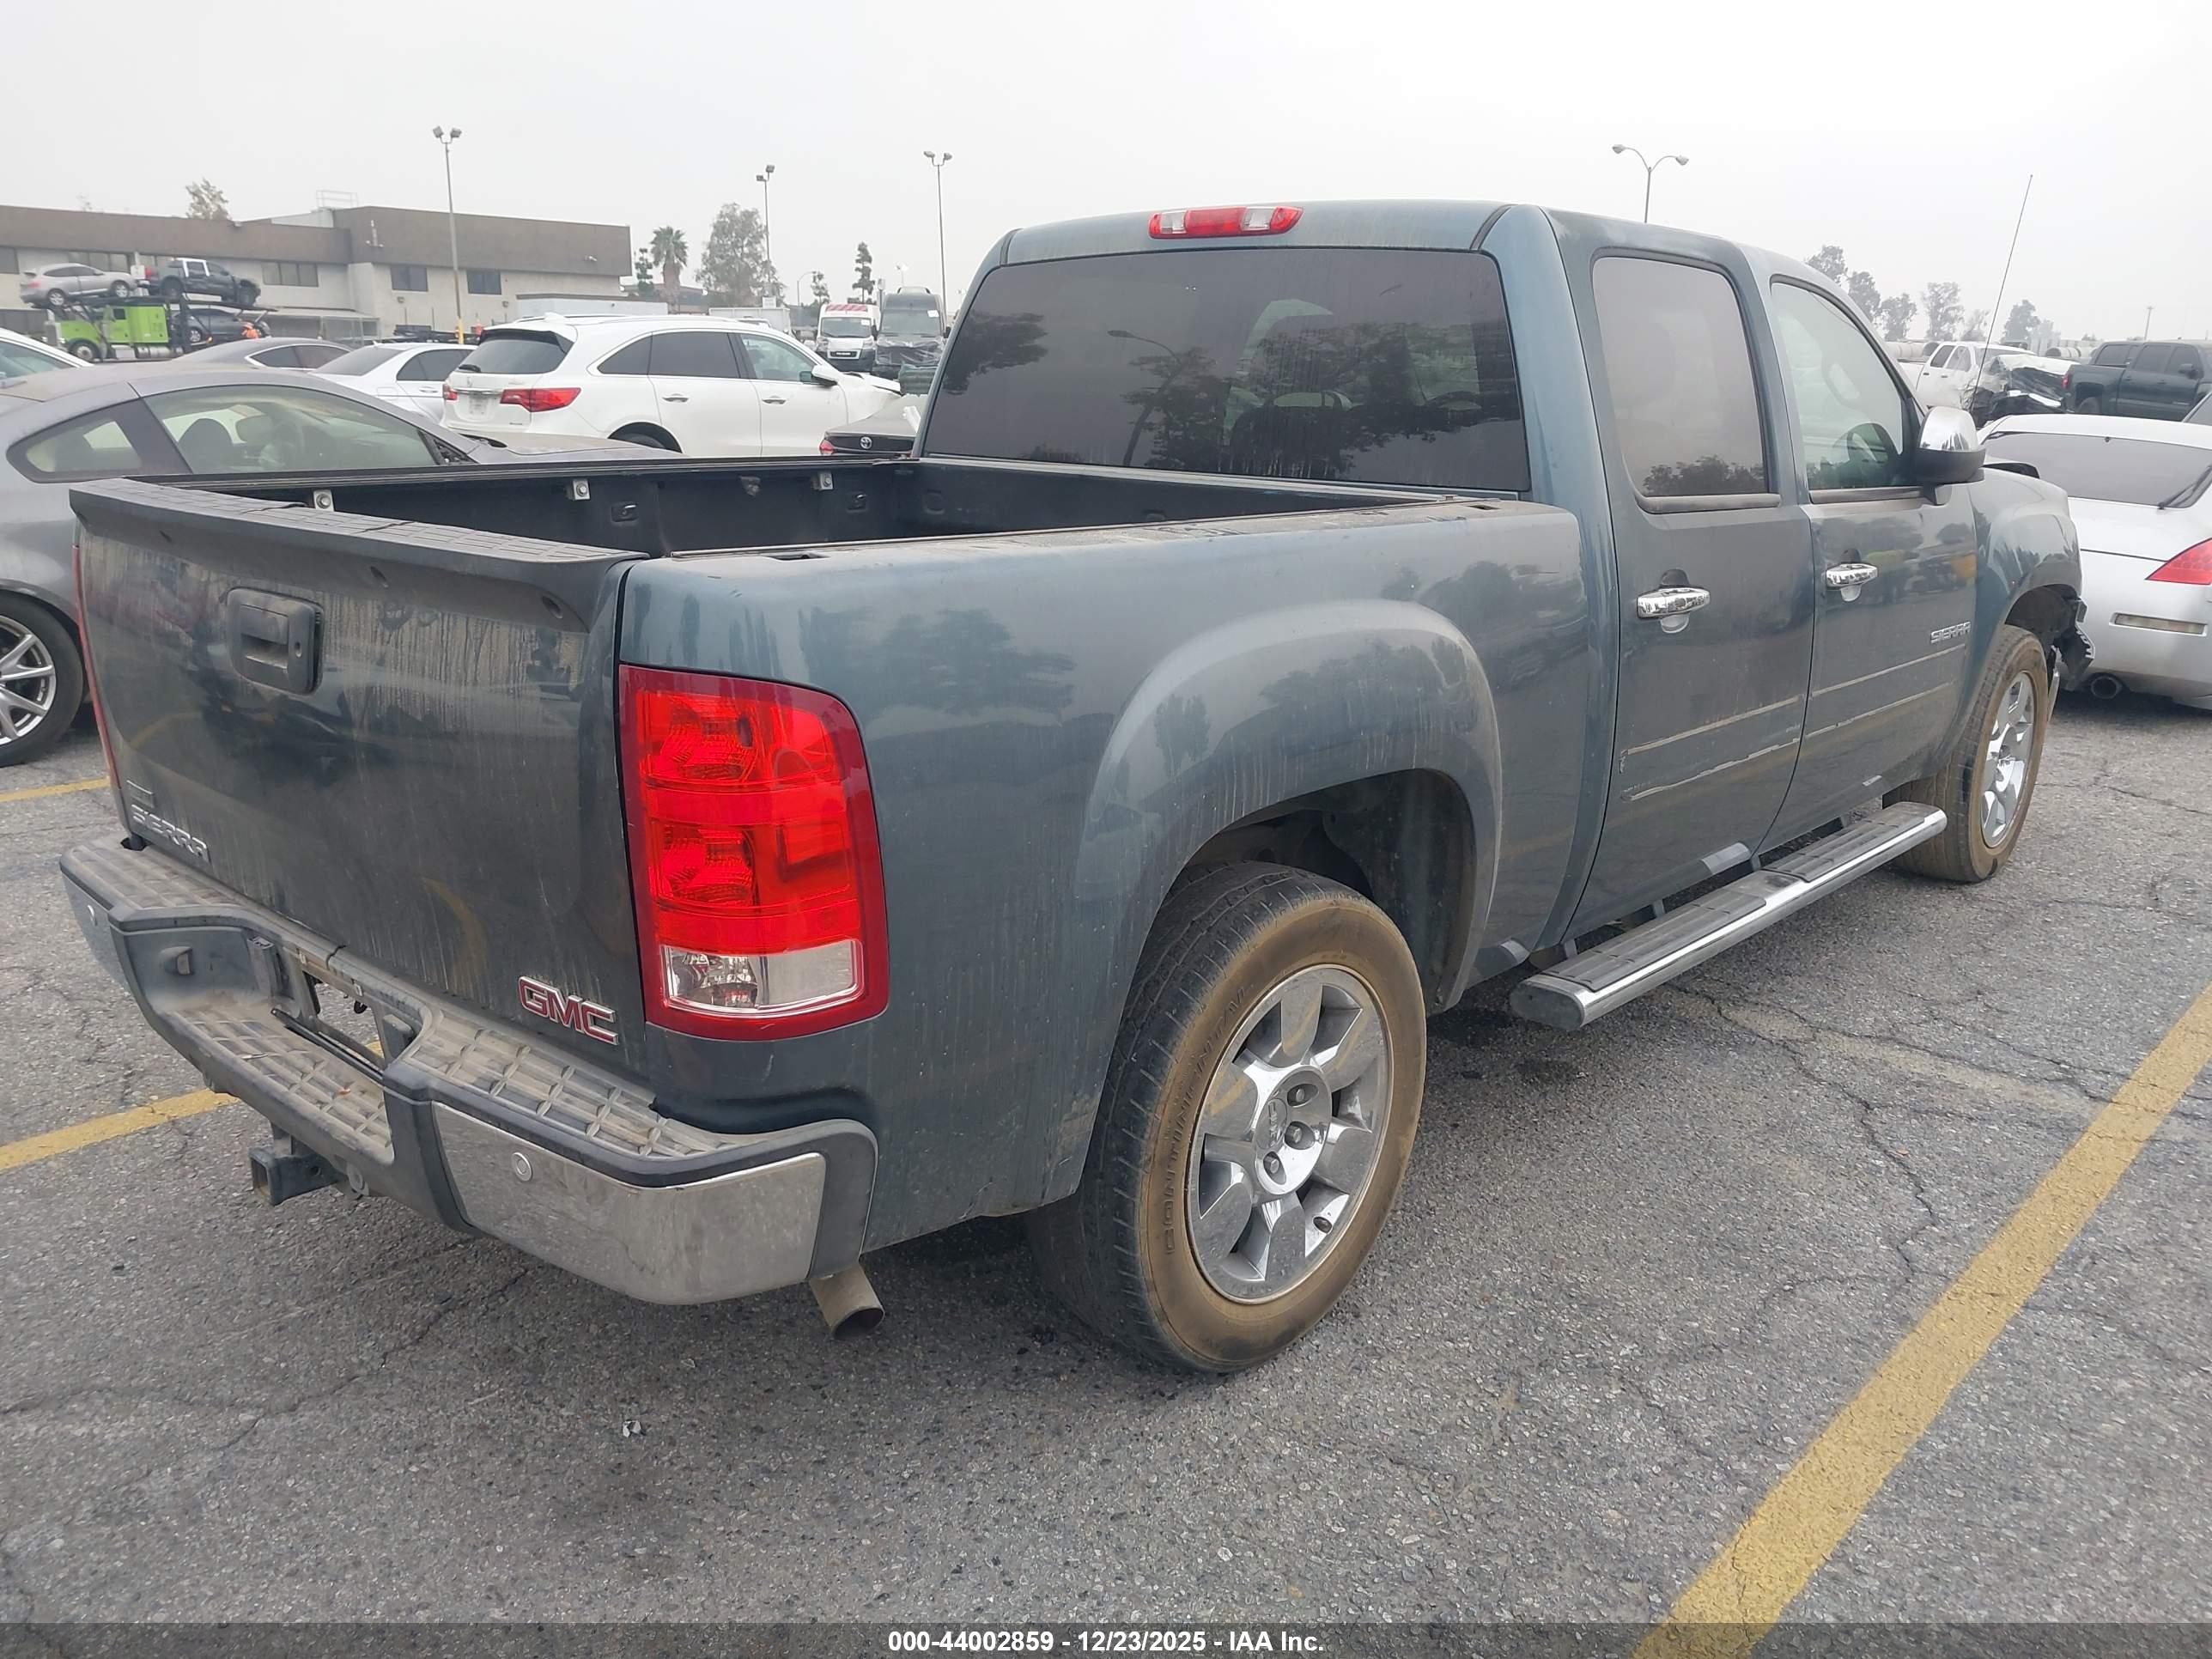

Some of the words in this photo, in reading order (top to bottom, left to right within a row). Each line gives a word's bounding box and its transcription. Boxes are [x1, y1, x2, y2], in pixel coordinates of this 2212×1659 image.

[1929, 621, 1972, 644] SIERRA
[131, 804, 211, 864] SIERRA
[517, 975, 619, 1045] GMC
